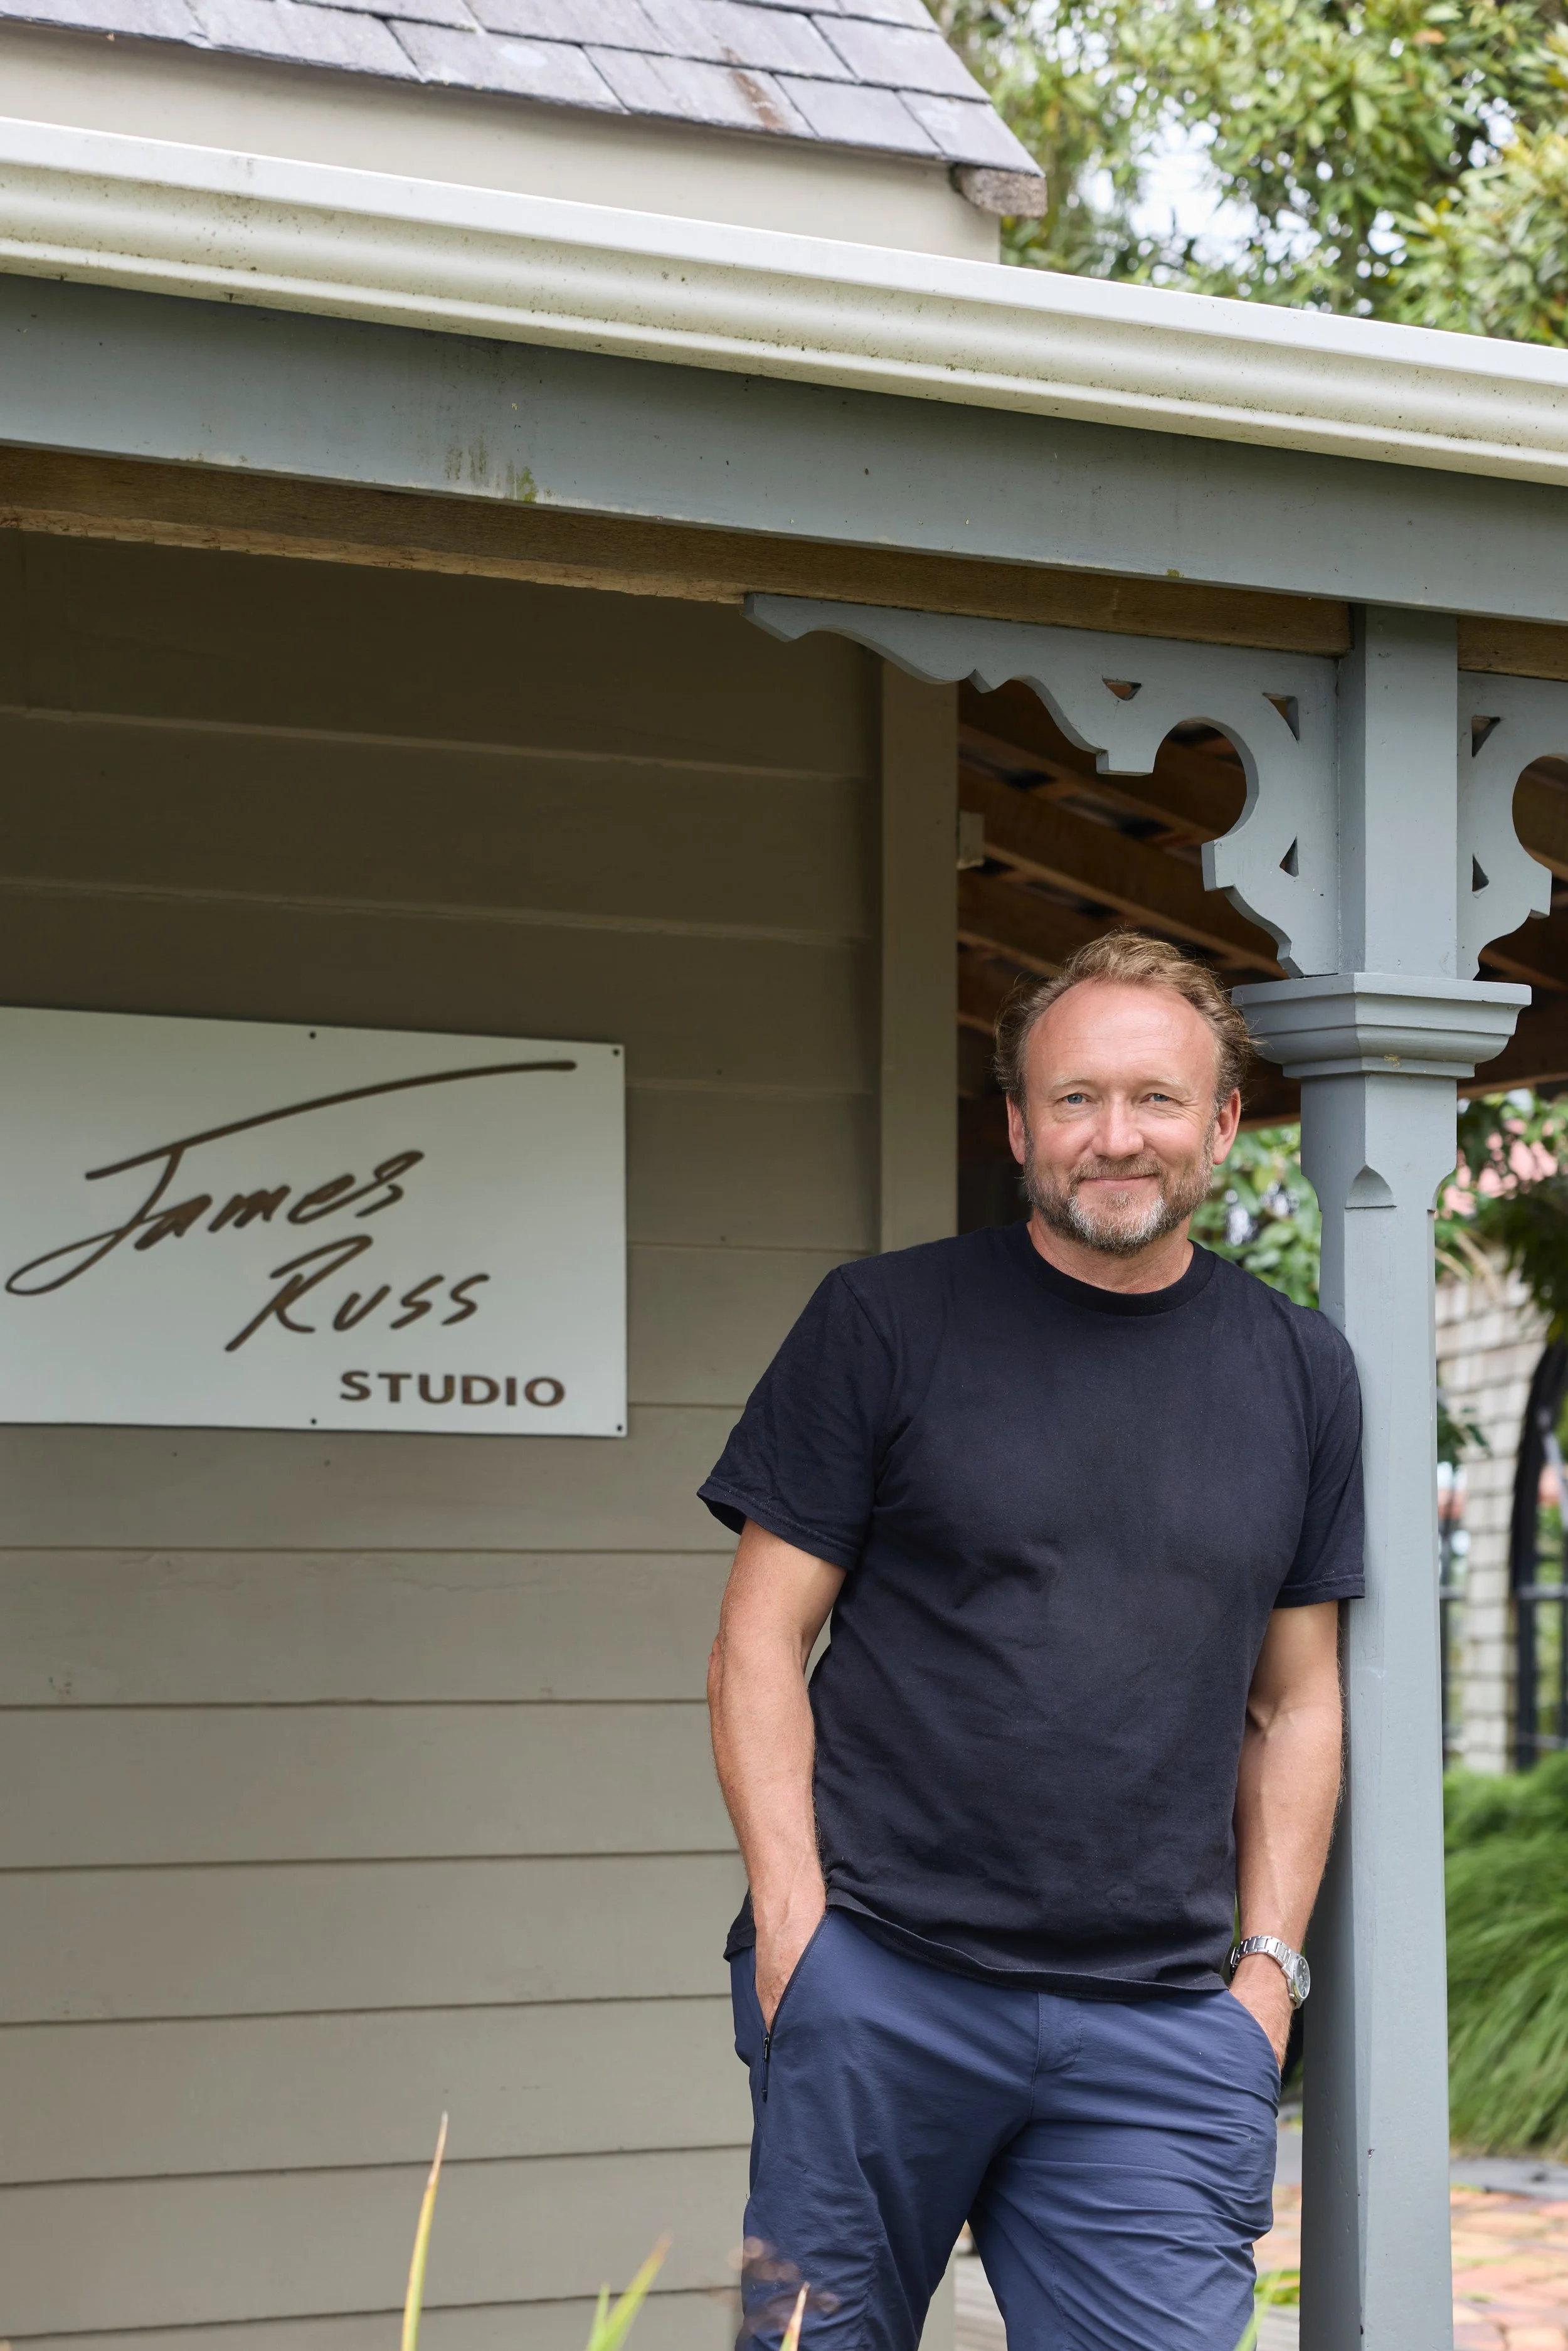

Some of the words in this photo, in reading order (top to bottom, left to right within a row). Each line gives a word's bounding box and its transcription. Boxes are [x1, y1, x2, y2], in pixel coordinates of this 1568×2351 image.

[4, 1060, 577, 1296] James
[224, 1234, 490, 1352] Russ
[339, 1369, 566, 1408] STUDIO
